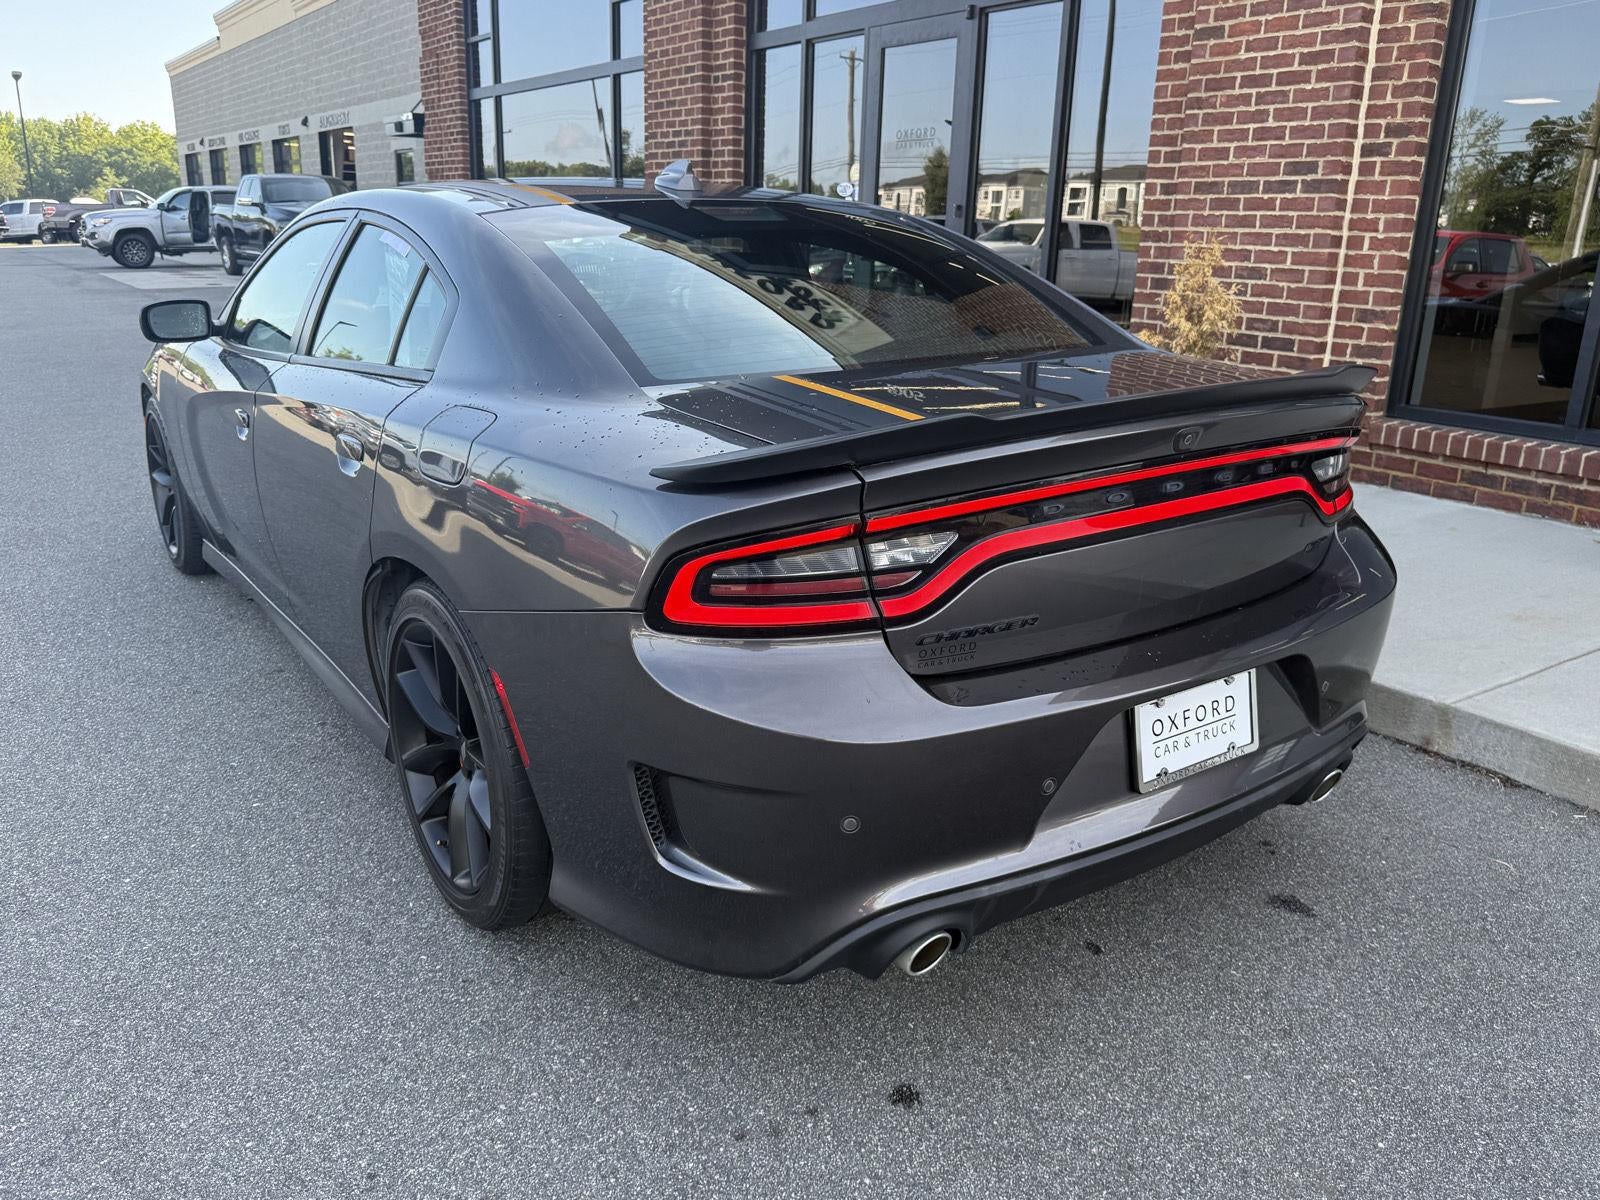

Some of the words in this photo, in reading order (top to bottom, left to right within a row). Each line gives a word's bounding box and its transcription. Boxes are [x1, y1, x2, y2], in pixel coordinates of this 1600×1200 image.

[896, 127, 936, 140] OXFORD
[915, 614, 1040, 646] CHARGER
[918, 641, 977, 659] OXFORD
[917, 660, 935, 669] CAR
[945, 654, 975, 665] TRUCK
[1152, 695, 1236, 737] OXFORD
[1154, 740, 1180, 759] CAR
[1183, 735, 1192, 748] &
[1194, 720, 1237, 744] TRUCK
[1153, 767, 1190, 788] OXFORD
